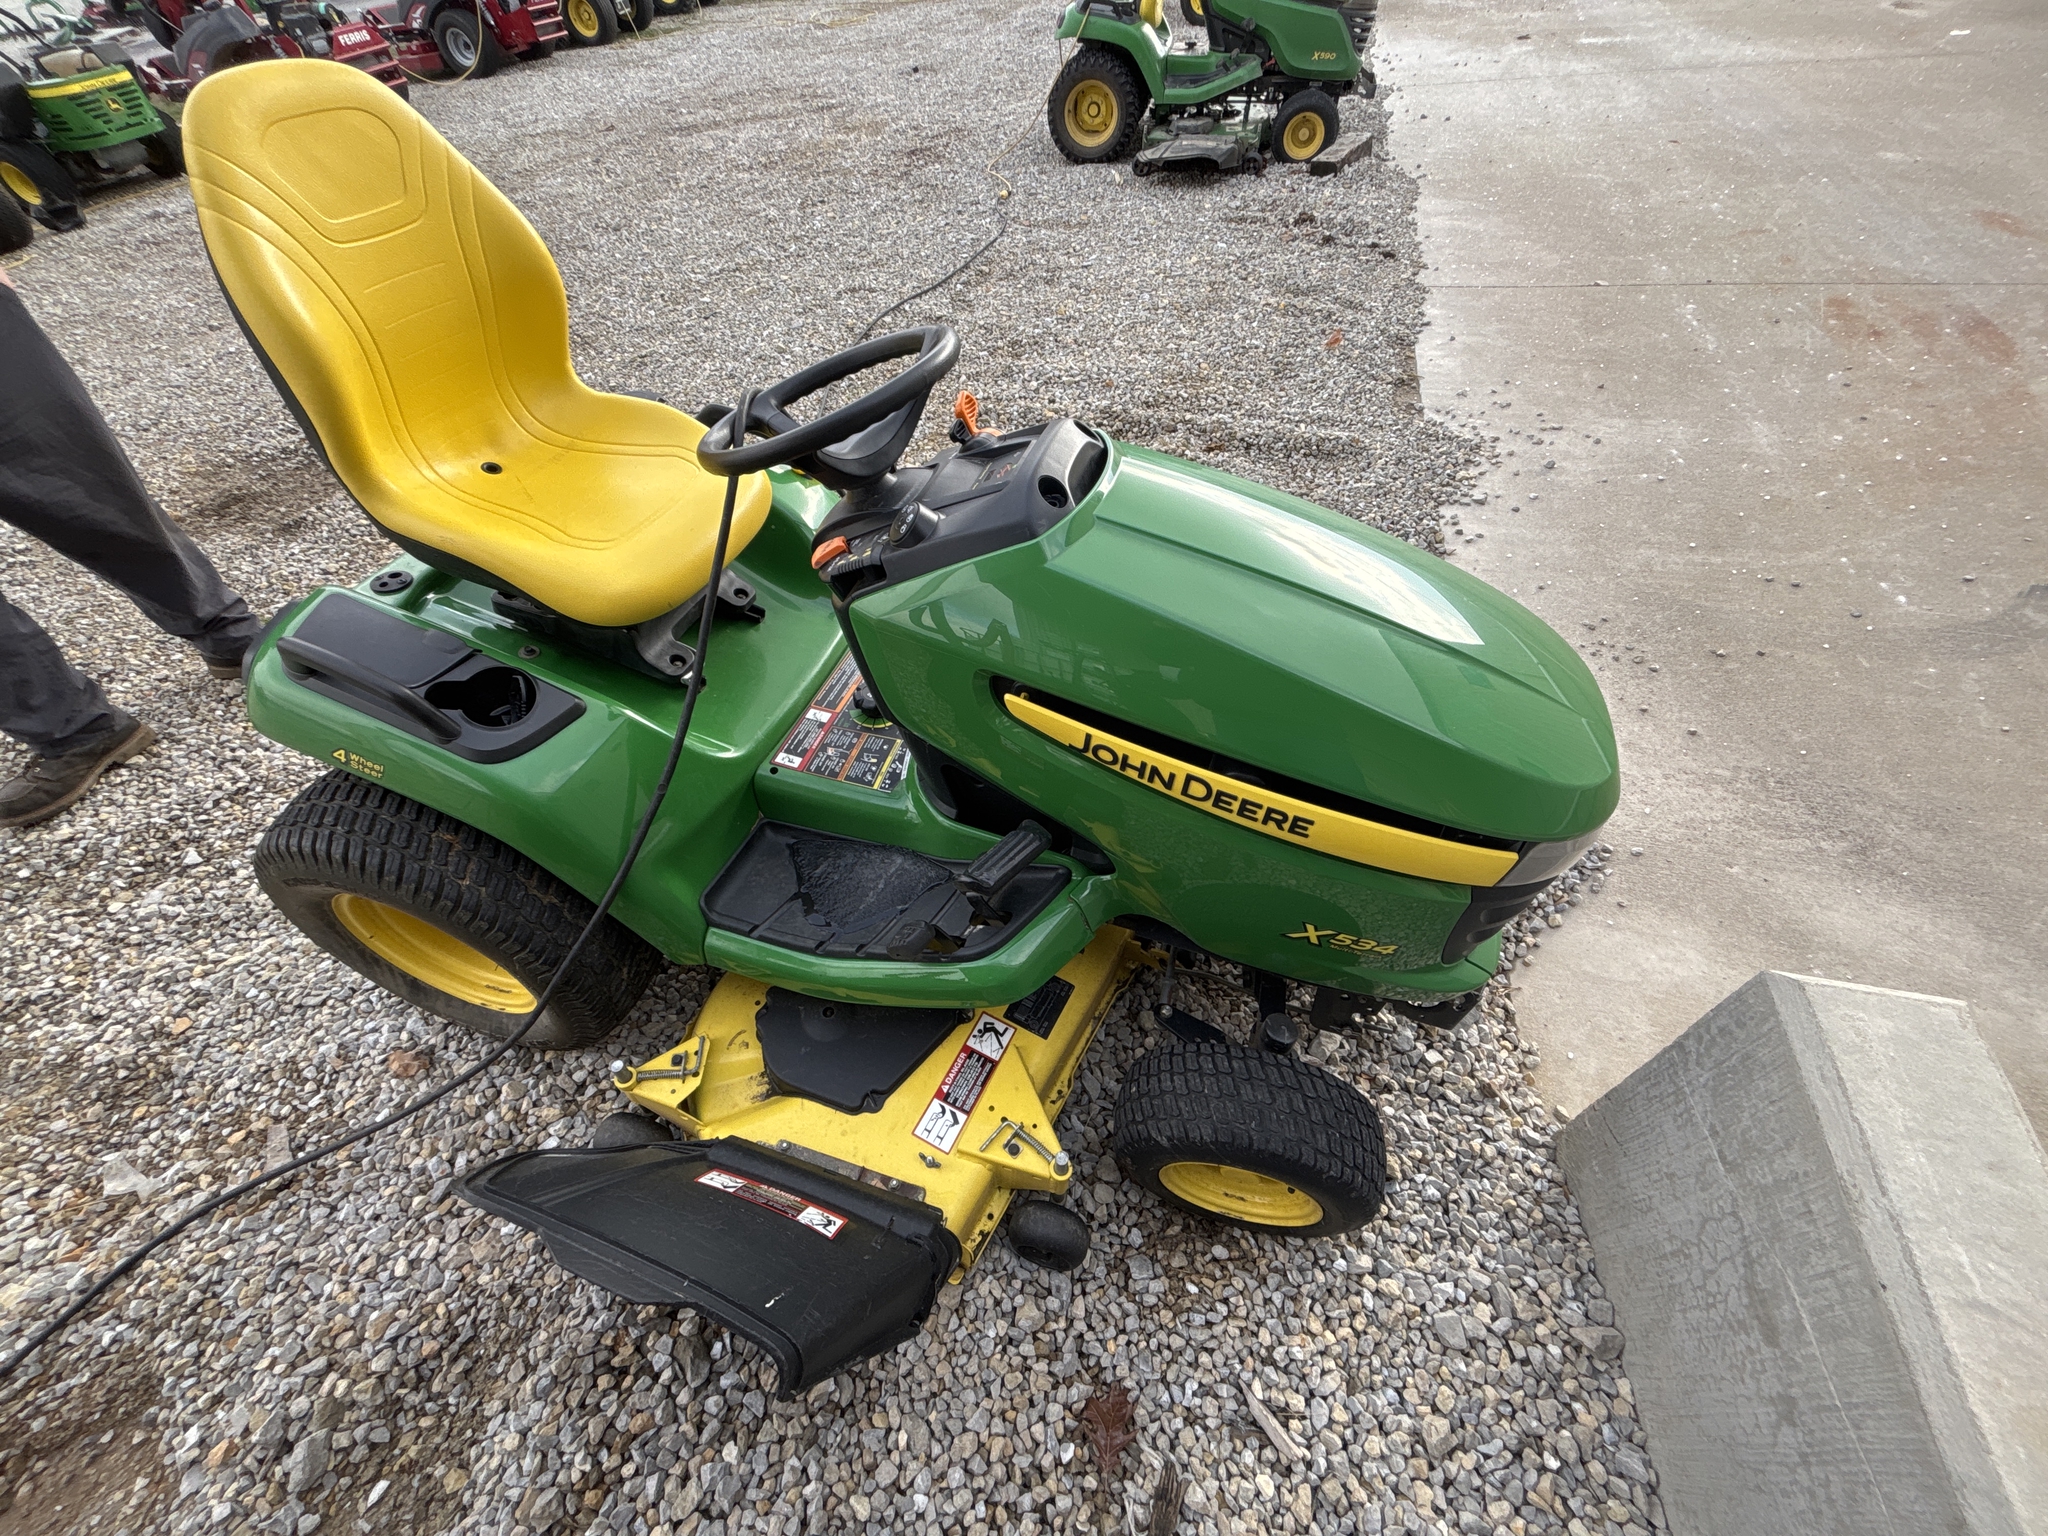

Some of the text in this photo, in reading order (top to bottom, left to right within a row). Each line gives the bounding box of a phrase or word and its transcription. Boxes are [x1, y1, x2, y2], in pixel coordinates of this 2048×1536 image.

[337, 29, 371, 47] FERRIS
[1311, 51, 1336, 61] X590
[332, 749, 384, 772] 4 Wheel
[349, 760, 384, 779] Steer
[1069, 732, 1316, 839] JOHN DEERE
[1283, 921, 1400, 956] X534
[944, 1051, 967, 1084] DANGER
[768, 1186, 802, 1202] DANGER
